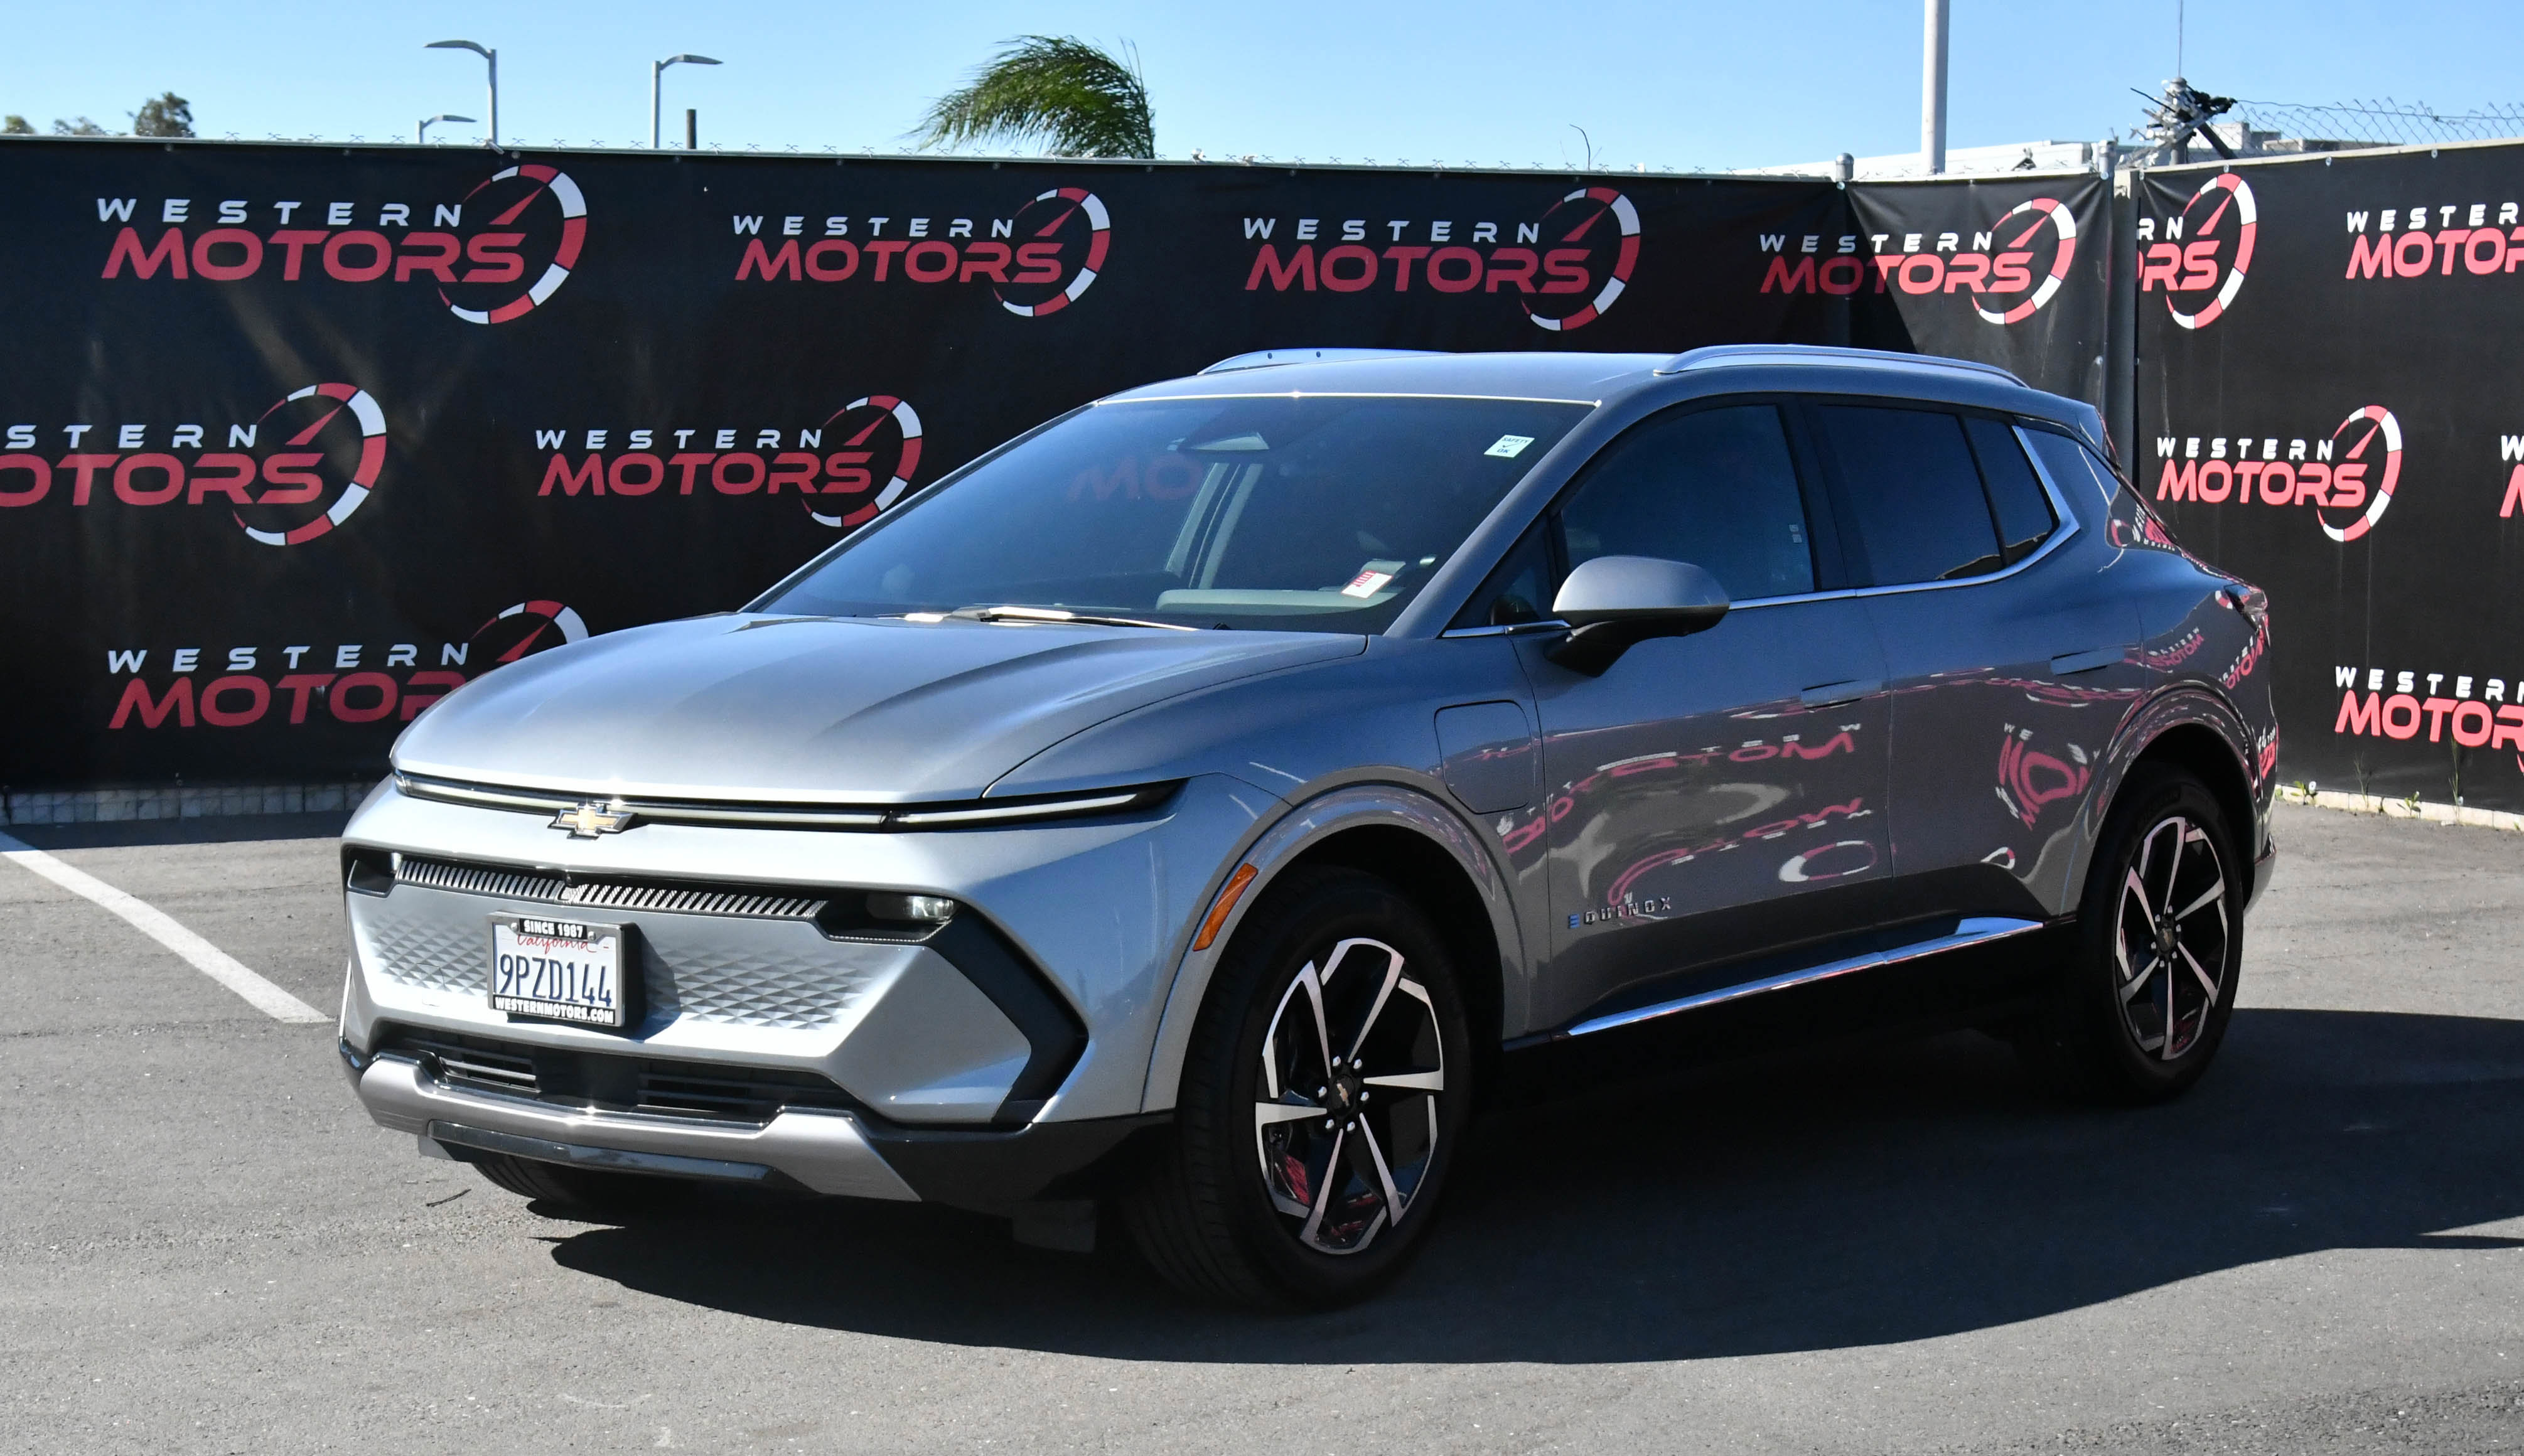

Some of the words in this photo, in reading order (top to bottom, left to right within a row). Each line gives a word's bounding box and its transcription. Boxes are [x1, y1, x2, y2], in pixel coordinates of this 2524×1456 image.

[98, 198, 462, 227] WESTERN
[733, 215, 1013, 238] WESTERN
[1244, 218, 1539, 244] WESTERN
[1759, 231, 1993, 253] WESTERN
[102, 227, 526, 283] MOTORS
[735, 239, 1063, 283] MOTORS
[1245, 244, 1591, 294] MOTORS
[1759, 252, 2034, 295] MOTORS
[535, 429, 822, 450] WESTERN
[2157, 437, 2334, 461] WESTERN
[538, 452, 873, 496] MOTORS
[2156, 459, 2368, 507] MOTORS
[108, 643, 469, 673] WESTERN
[109, 671, 468, 729] MOTOR
[523, 919, 555, 936] SINCE
[557, 923, 583, 938] 1987
[1569, 897, 1671, 929] EQUINOX
[500, 953, 612, 1007] 9PZD144
[494, 997, 615, 1024] WESTERNMOTORS.COM
